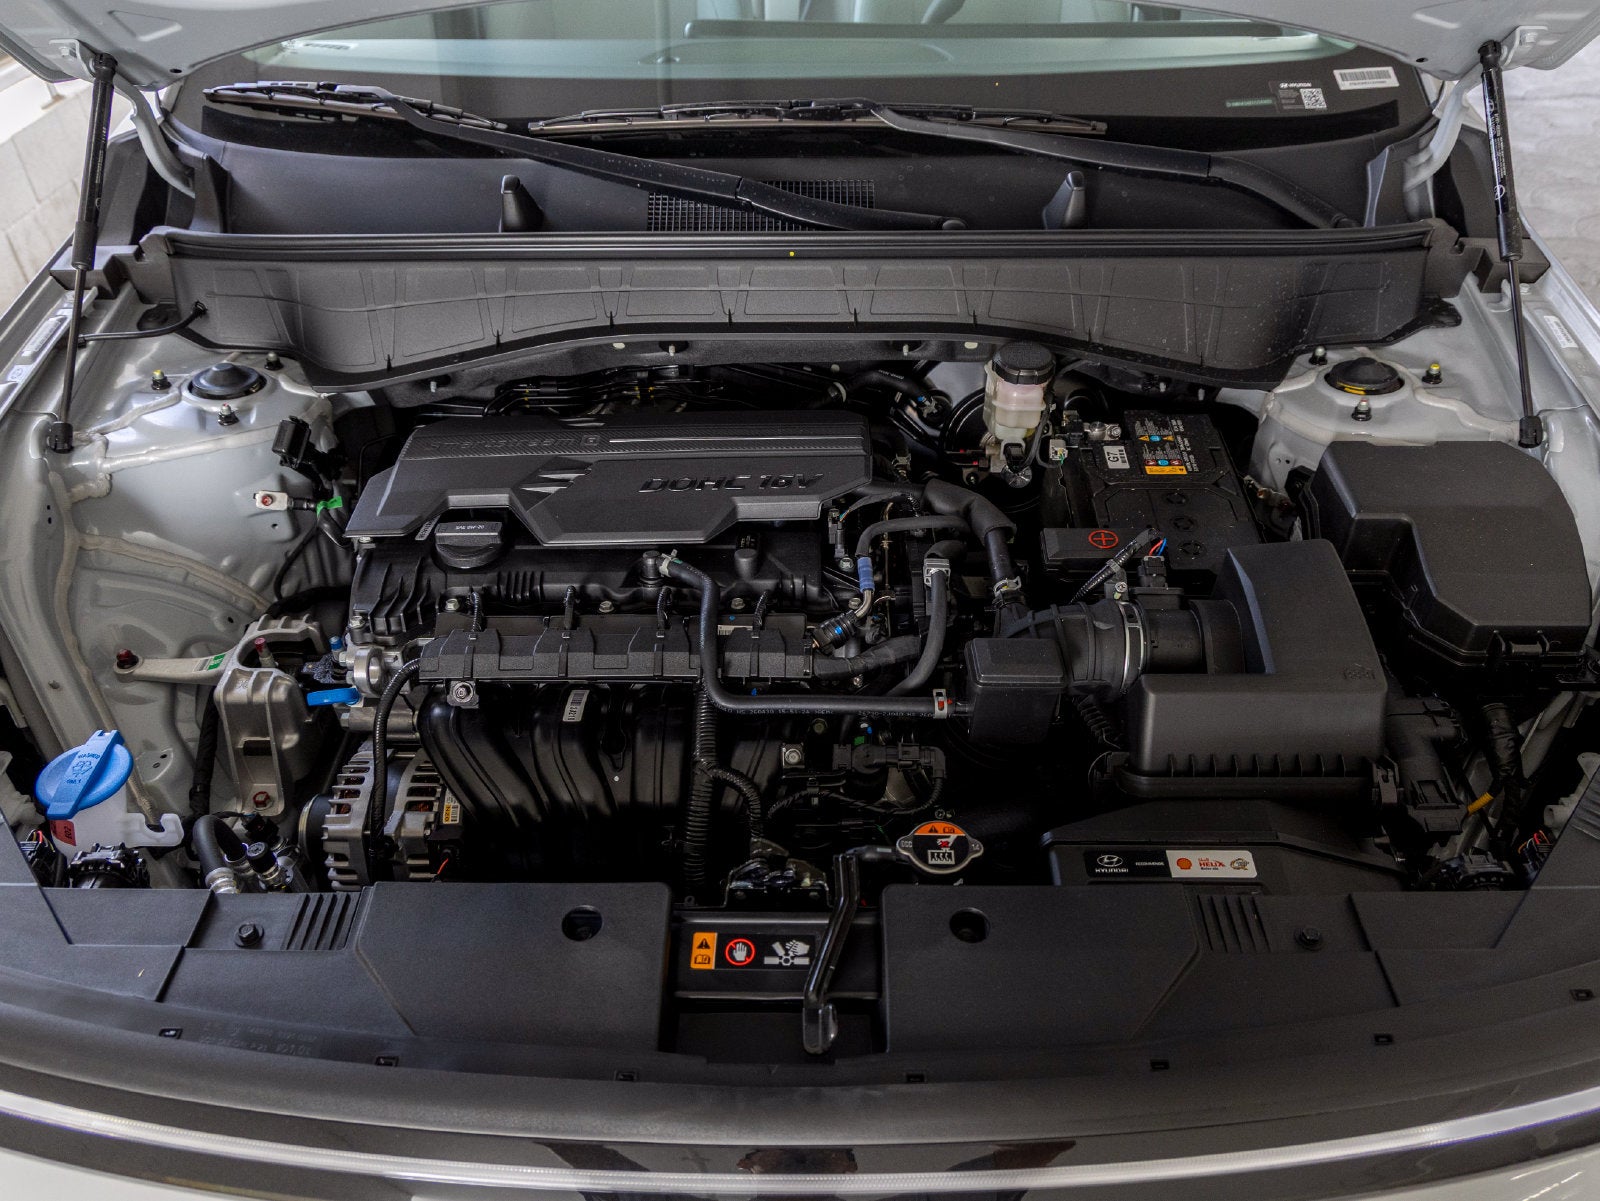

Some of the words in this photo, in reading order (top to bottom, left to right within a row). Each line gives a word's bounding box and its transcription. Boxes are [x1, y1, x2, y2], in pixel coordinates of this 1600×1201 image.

[1106, 451, 1120, 463] G7
[638, 474, 751, 493] DOHC
[758, 473, 823, 490] 16V
